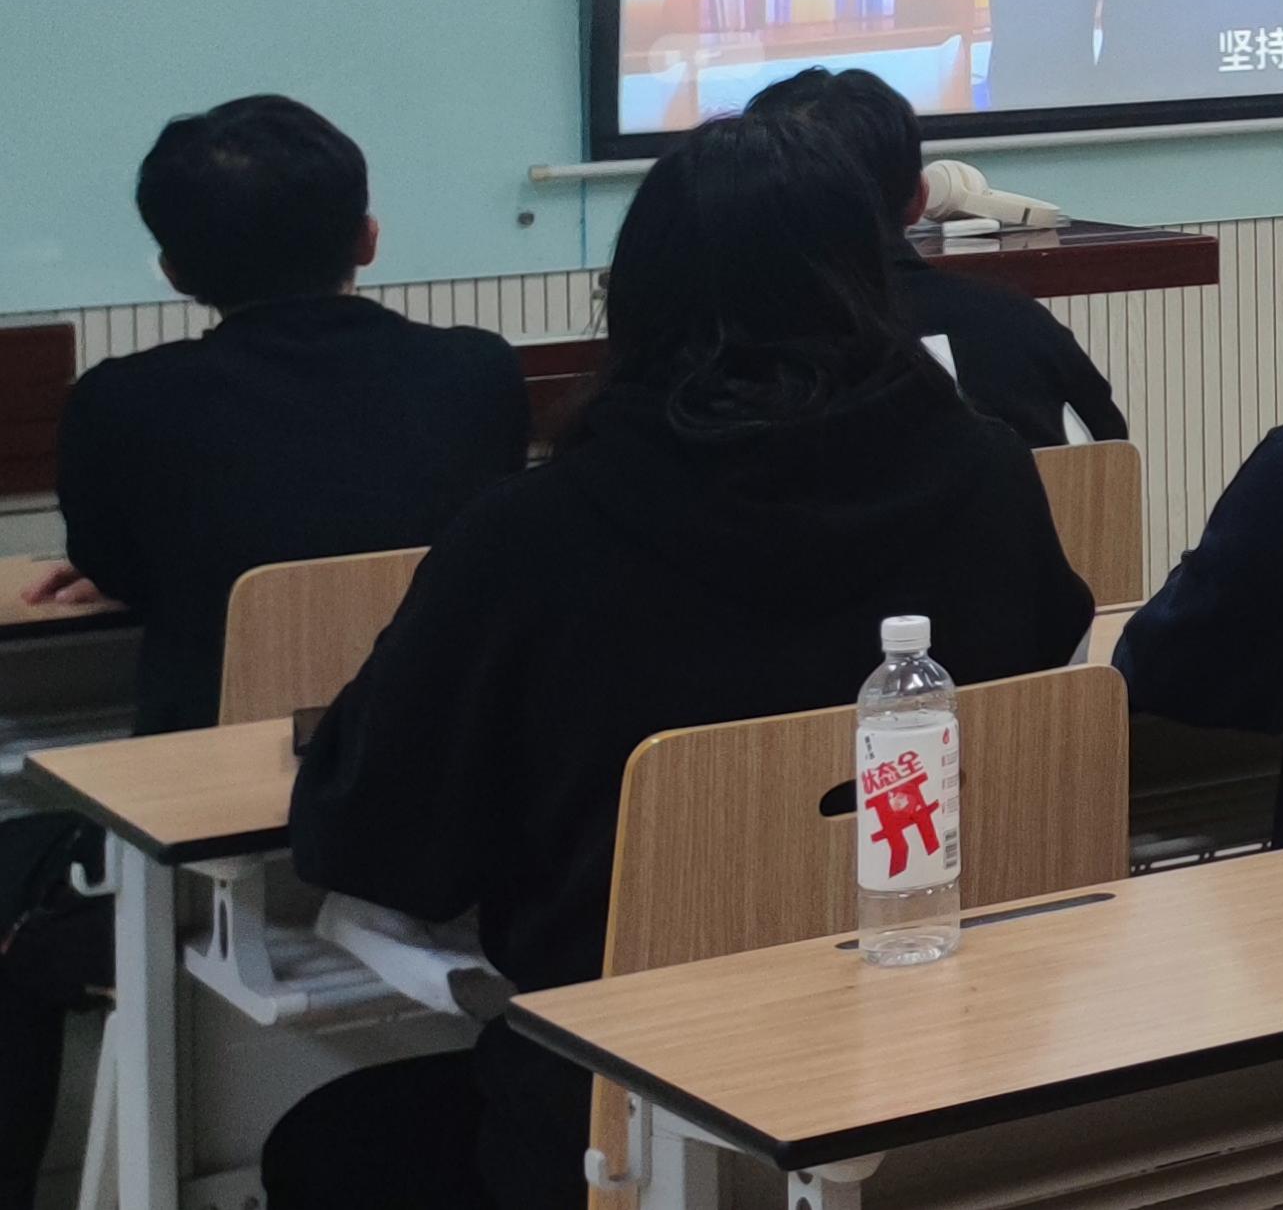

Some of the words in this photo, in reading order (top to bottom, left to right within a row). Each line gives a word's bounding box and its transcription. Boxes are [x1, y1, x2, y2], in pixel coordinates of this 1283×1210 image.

[861, 749, 924, 795] 状态全
[864, 771, 940, 879] 开
